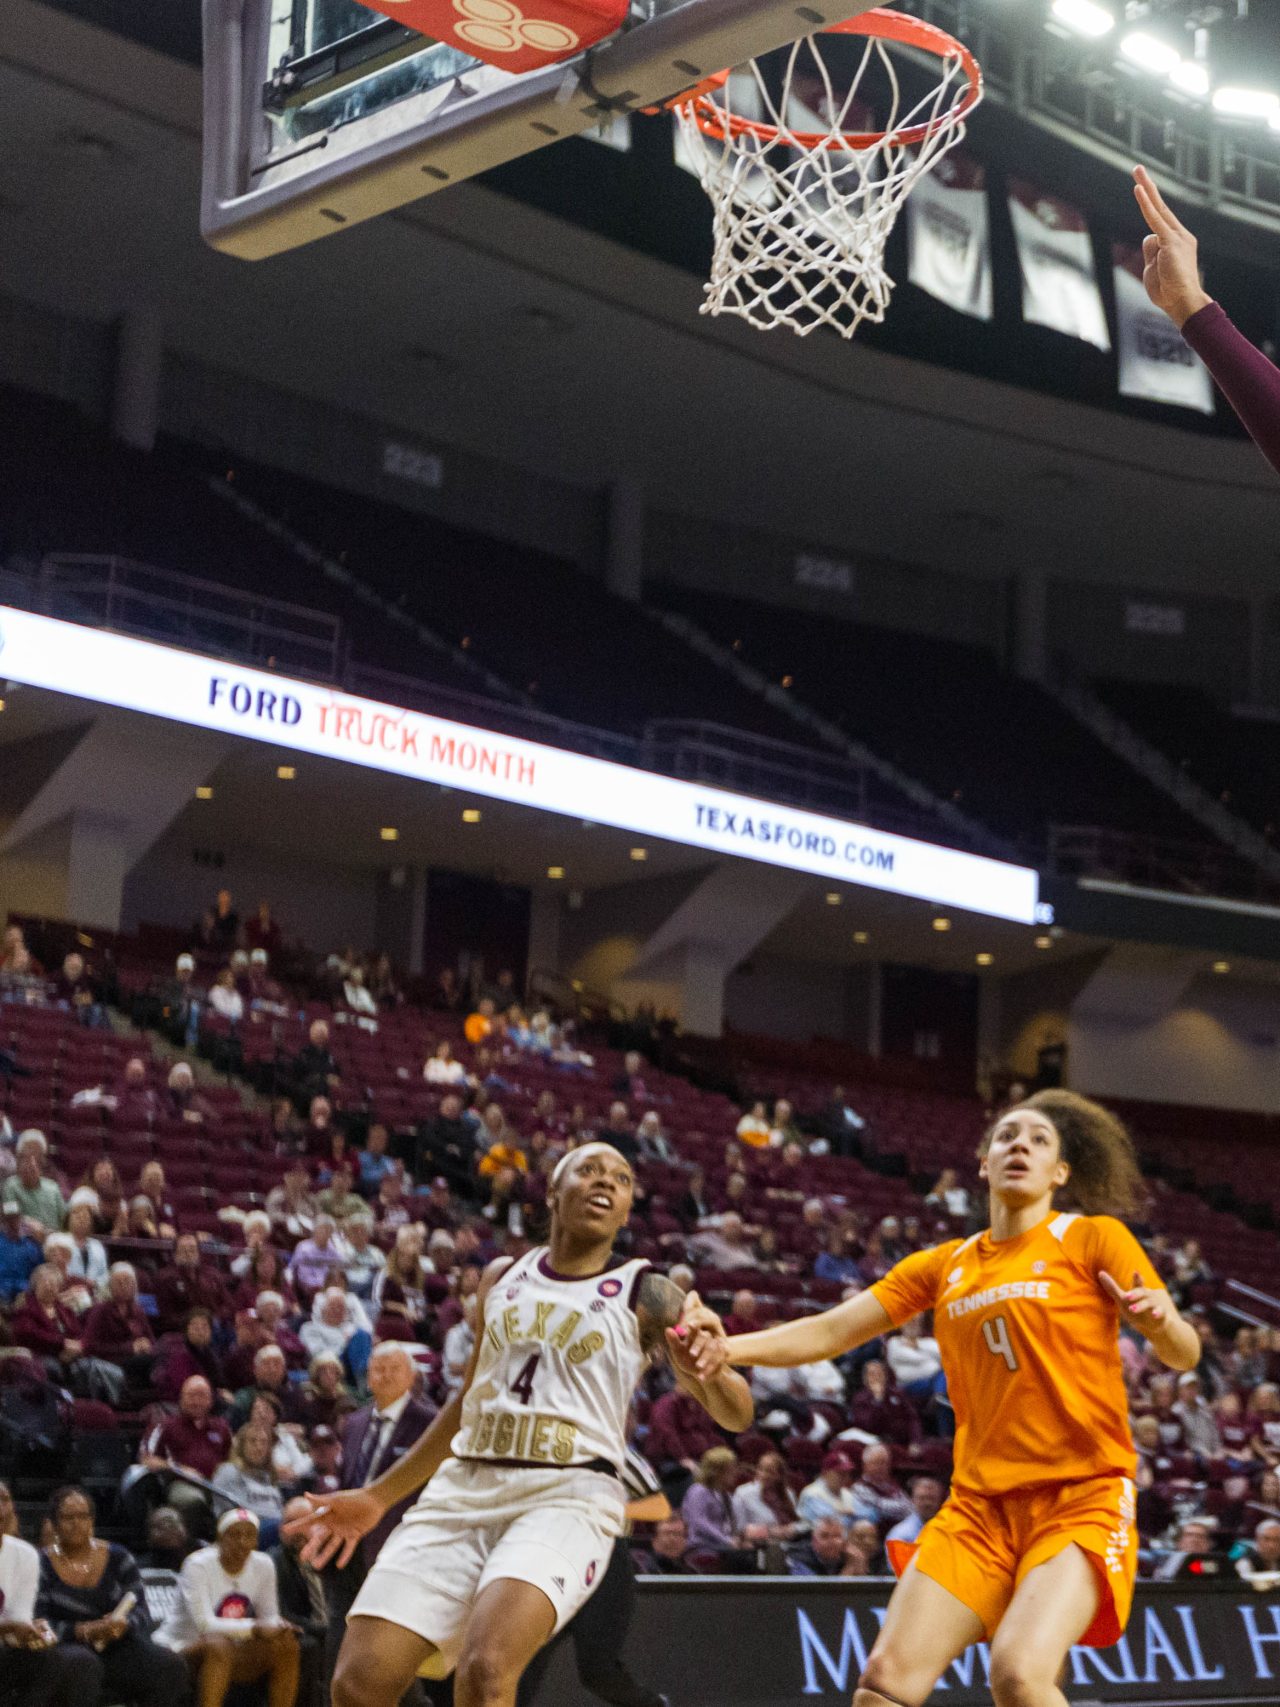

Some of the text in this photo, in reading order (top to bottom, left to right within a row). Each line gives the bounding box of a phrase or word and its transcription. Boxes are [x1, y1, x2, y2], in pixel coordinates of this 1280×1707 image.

[208, 677, 536, 786] FORD TRUCK MONTH
[694, 803, 896, 873] TEXASFORD.COM
[947, 1281, 1051, 1320] TENNESSEE
[982, 1316, 1018, 1371] 4
[510, 1352, 542, 1405] 4
